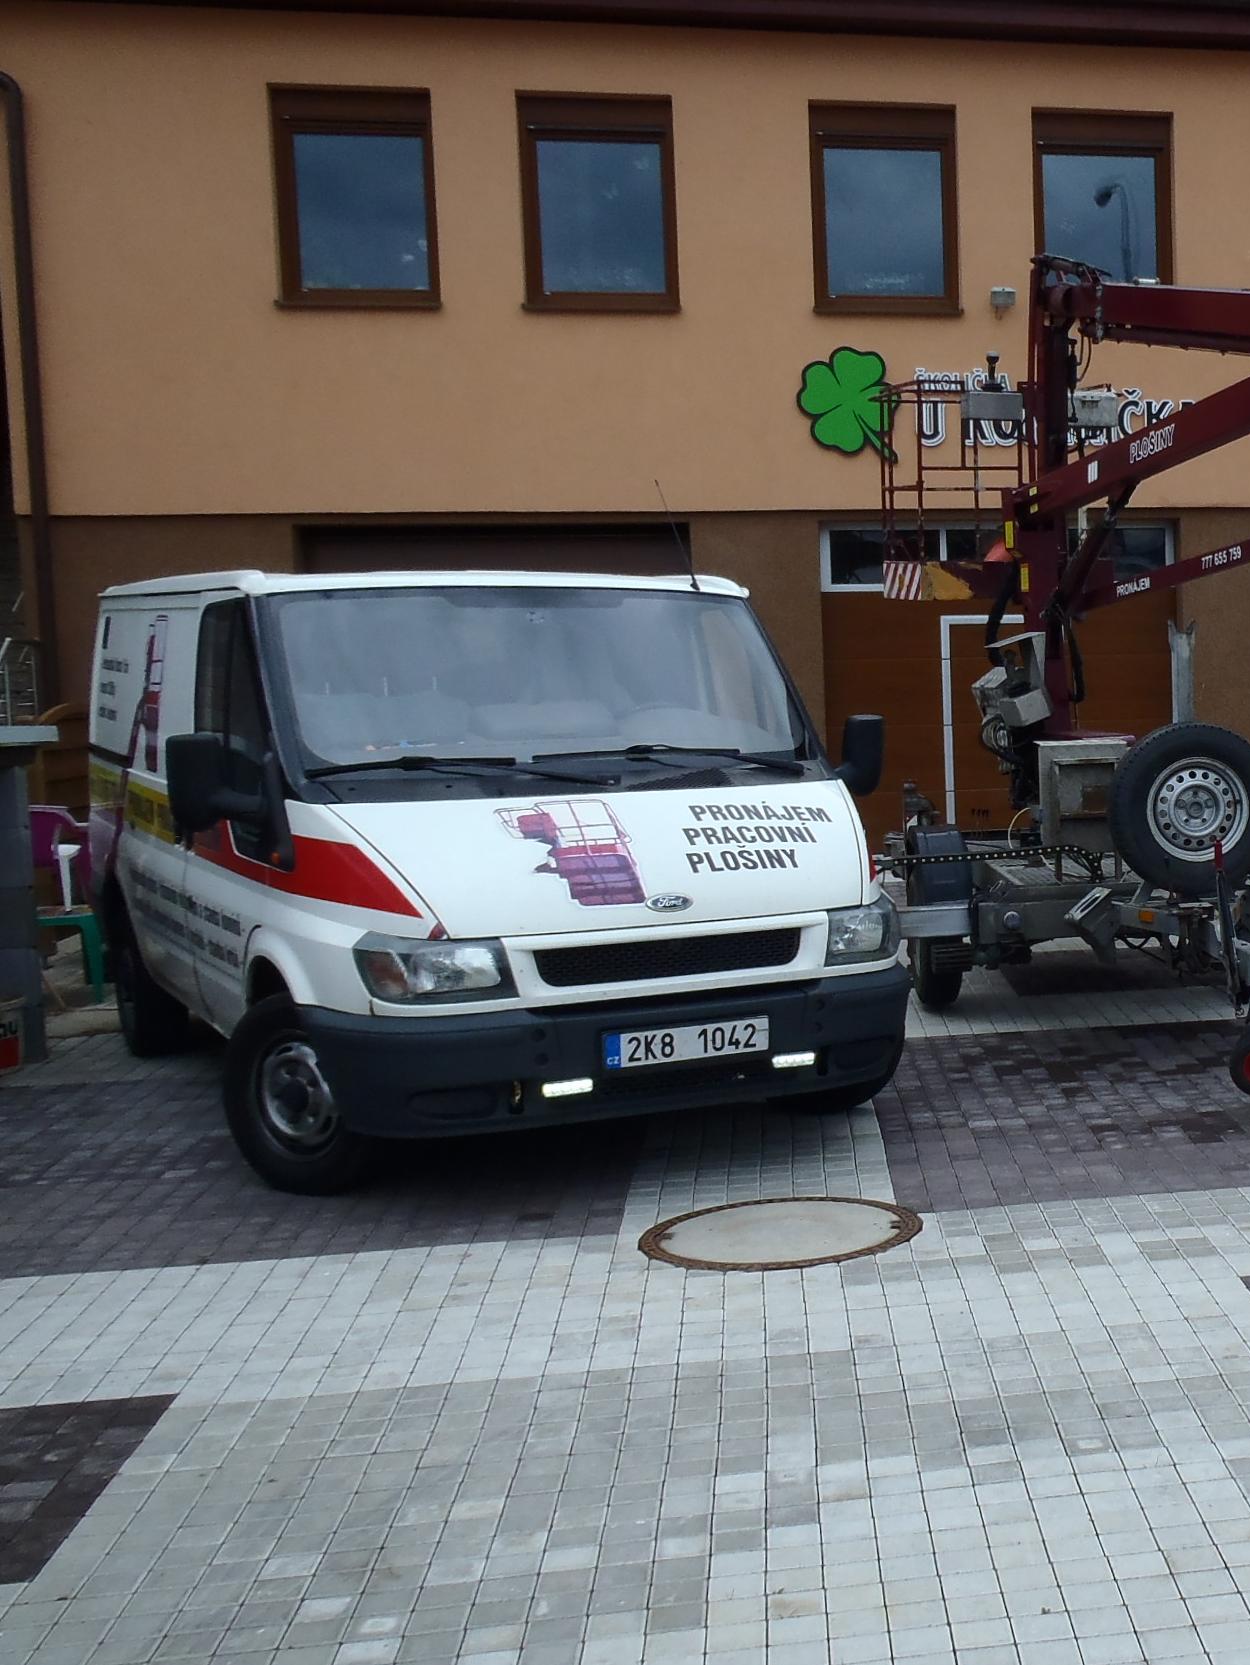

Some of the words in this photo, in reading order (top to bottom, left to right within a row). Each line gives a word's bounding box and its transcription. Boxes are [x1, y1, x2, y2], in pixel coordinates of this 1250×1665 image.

[914, 367, 1011, 392] ŠKOLIČA
[915, 396, 946, 447] U
[1129, 424, 1176, 463] PLOŠINY
[1201, 554, 1213, 570] 777
[1214, 551, 1228, 566] 655
[1229, 546, 1242, 562] 759
[1116, 576, 1151, 597] PRONÁJEM
[688, 801, 833, 823] PRONÁJEM
[682, 822, 817, 846] PRACOVNÍ
[685, 844, 799, 873] PLOŠINY
[657, 896, 684, 907] Ford
[627, 1032, 675, 1063] 2K8
[697, 1022, 757, 1054] 1042
[606, 1056, 620, 1066] CZ
